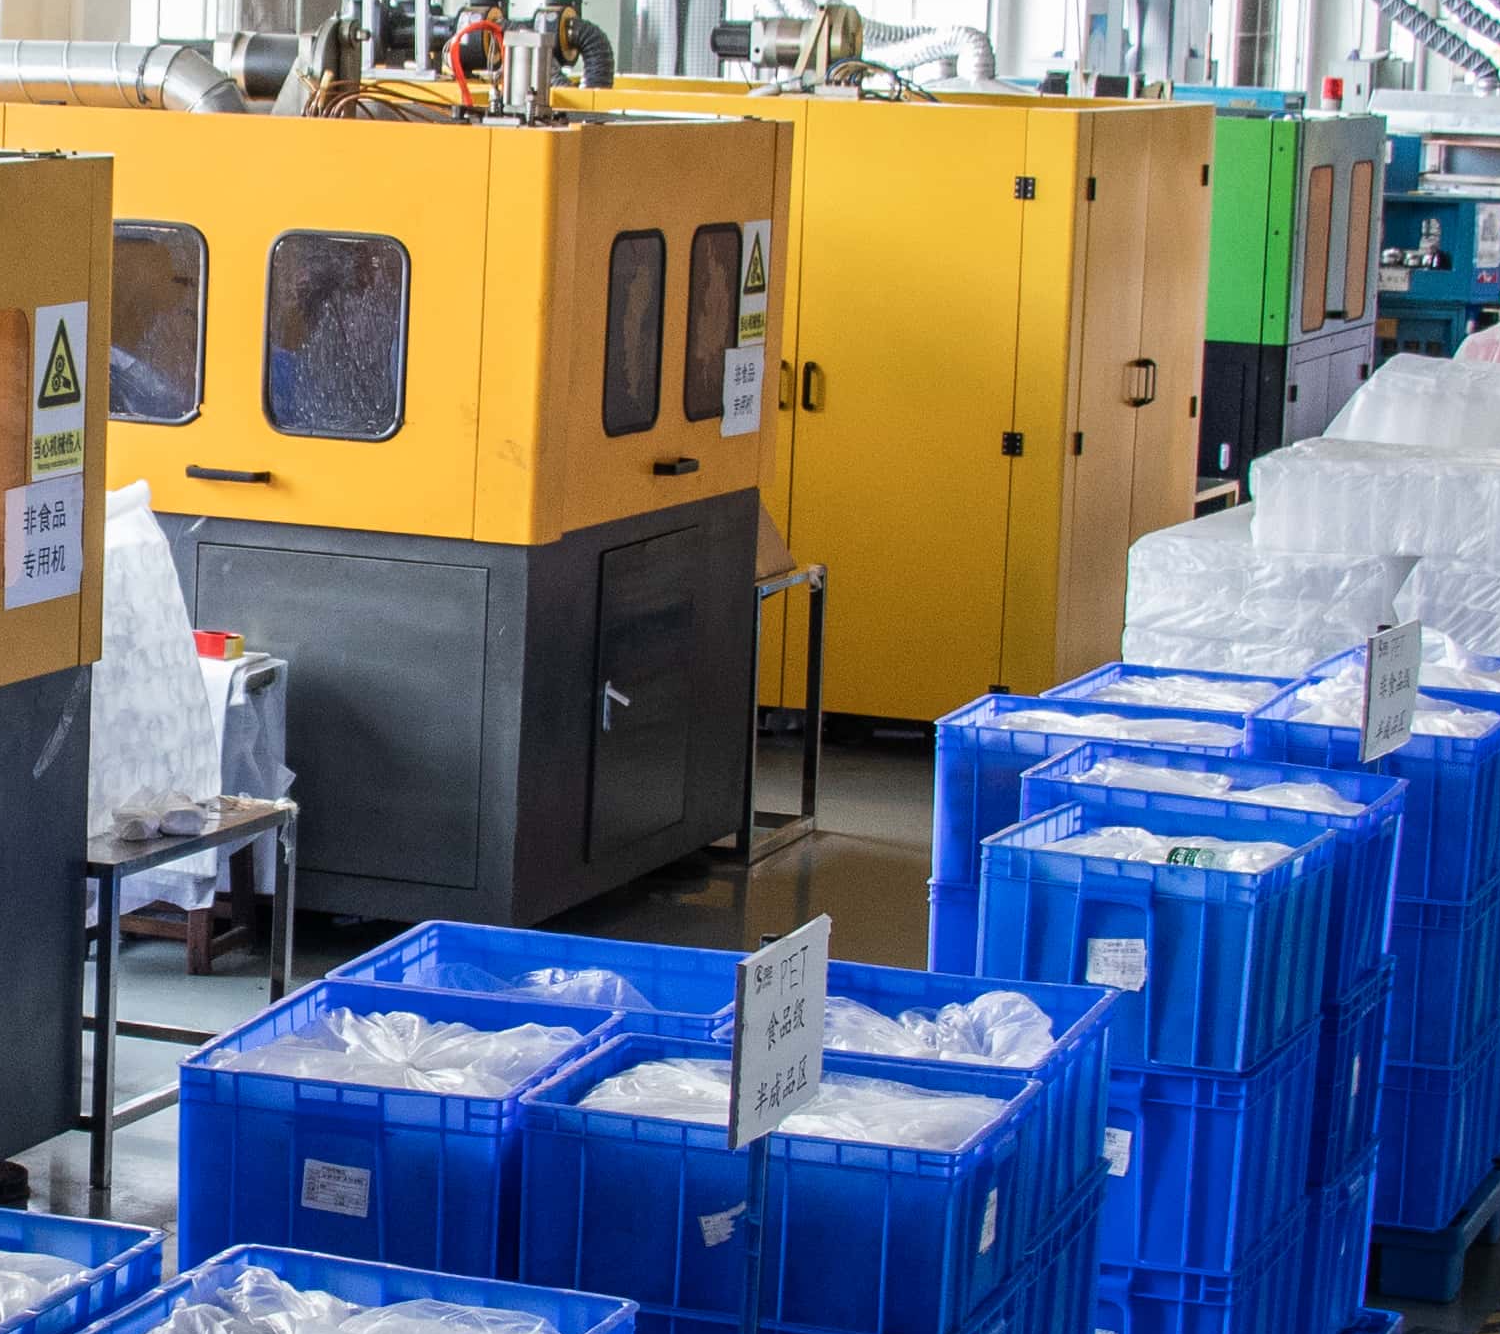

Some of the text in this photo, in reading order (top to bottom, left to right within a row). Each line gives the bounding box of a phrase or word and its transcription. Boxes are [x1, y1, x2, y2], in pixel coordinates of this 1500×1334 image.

[33, 433, 82, 459] 当心机械伤人
[22, 500, 66, 535] 非食品
[22, 544, 66, 579] 专用机
[780, 945, 809, 995] PET
[765, 998, 806, 1051] 食品级
[754, 1054, 809, 1118] 半成品区
